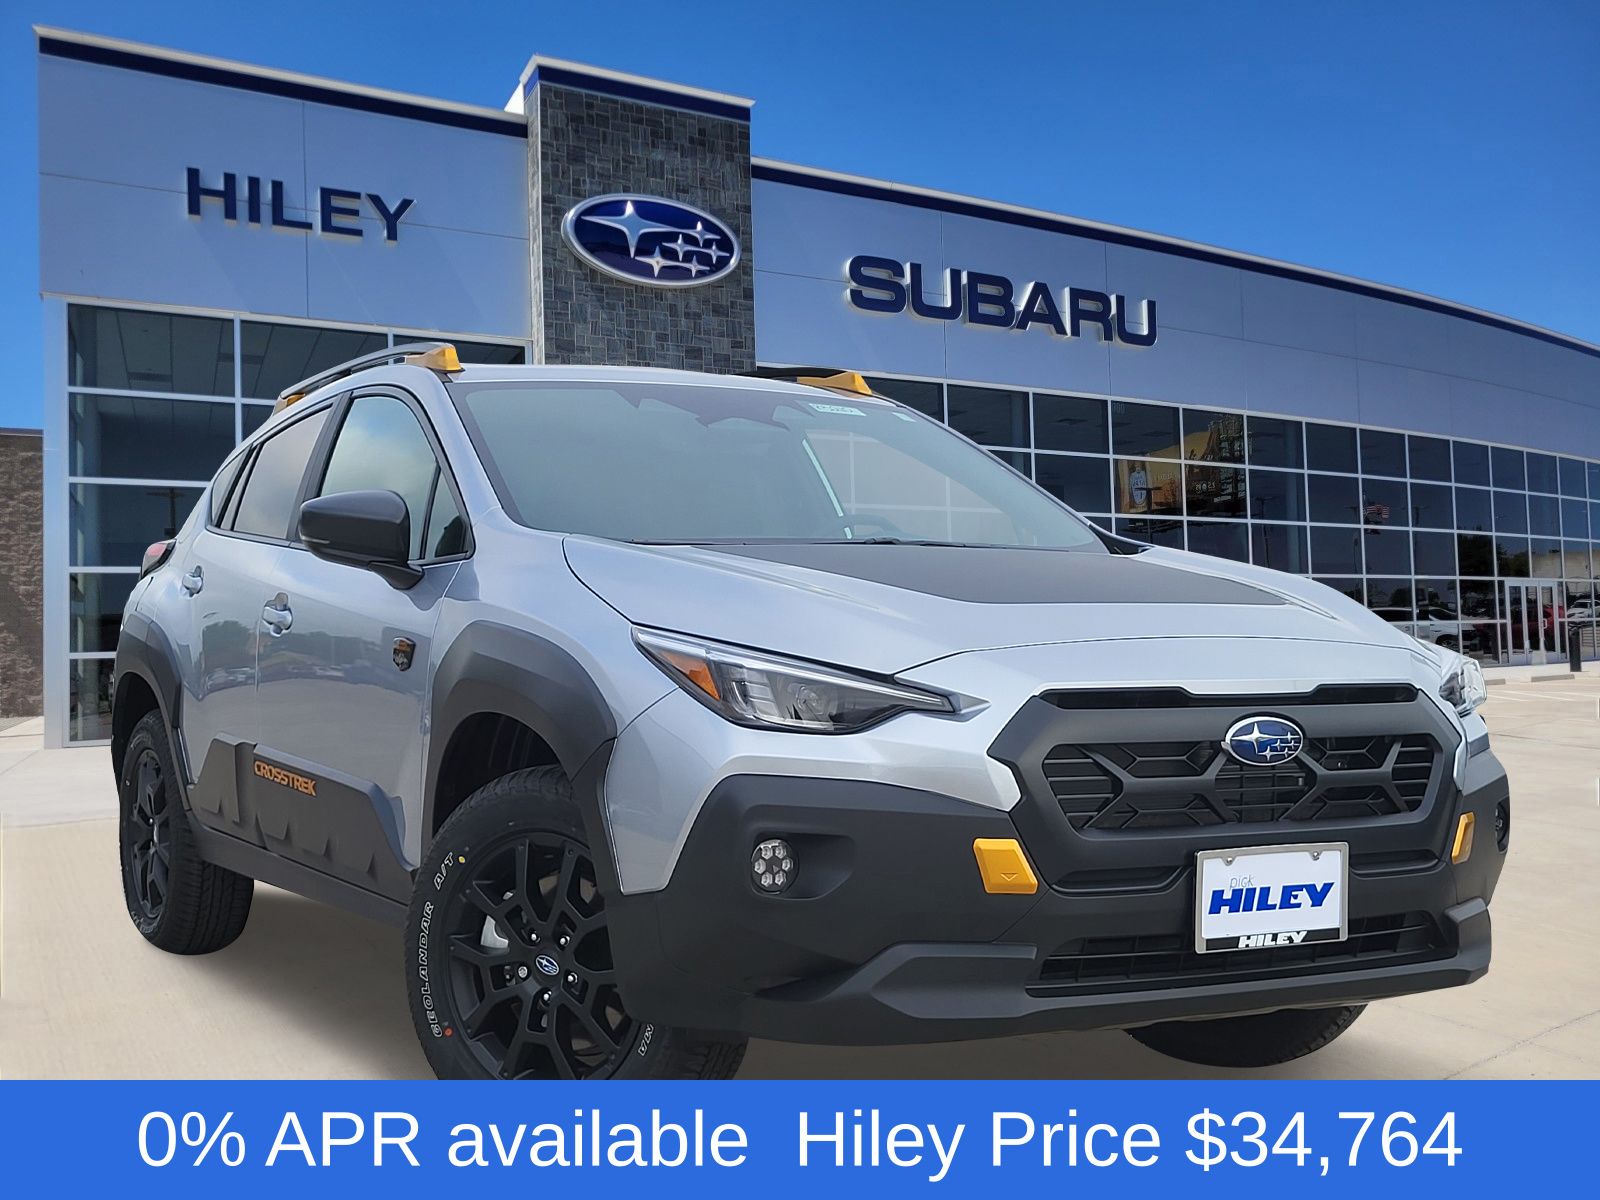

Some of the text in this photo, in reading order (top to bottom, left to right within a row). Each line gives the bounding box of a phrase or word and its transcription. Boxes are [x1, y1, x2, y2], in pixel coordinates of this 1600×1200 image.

[186, 167, 415, 242] HILEY
[847, 254, 1158, 347] SUBARU
[254, 760, 317, 796] CROSSTREK
[1208, 882, 1335, 915] HILEY
[419, 852, 454, 1038] GEOLANDAR A/T
[1238, 931, 1307, 949] HILEY
